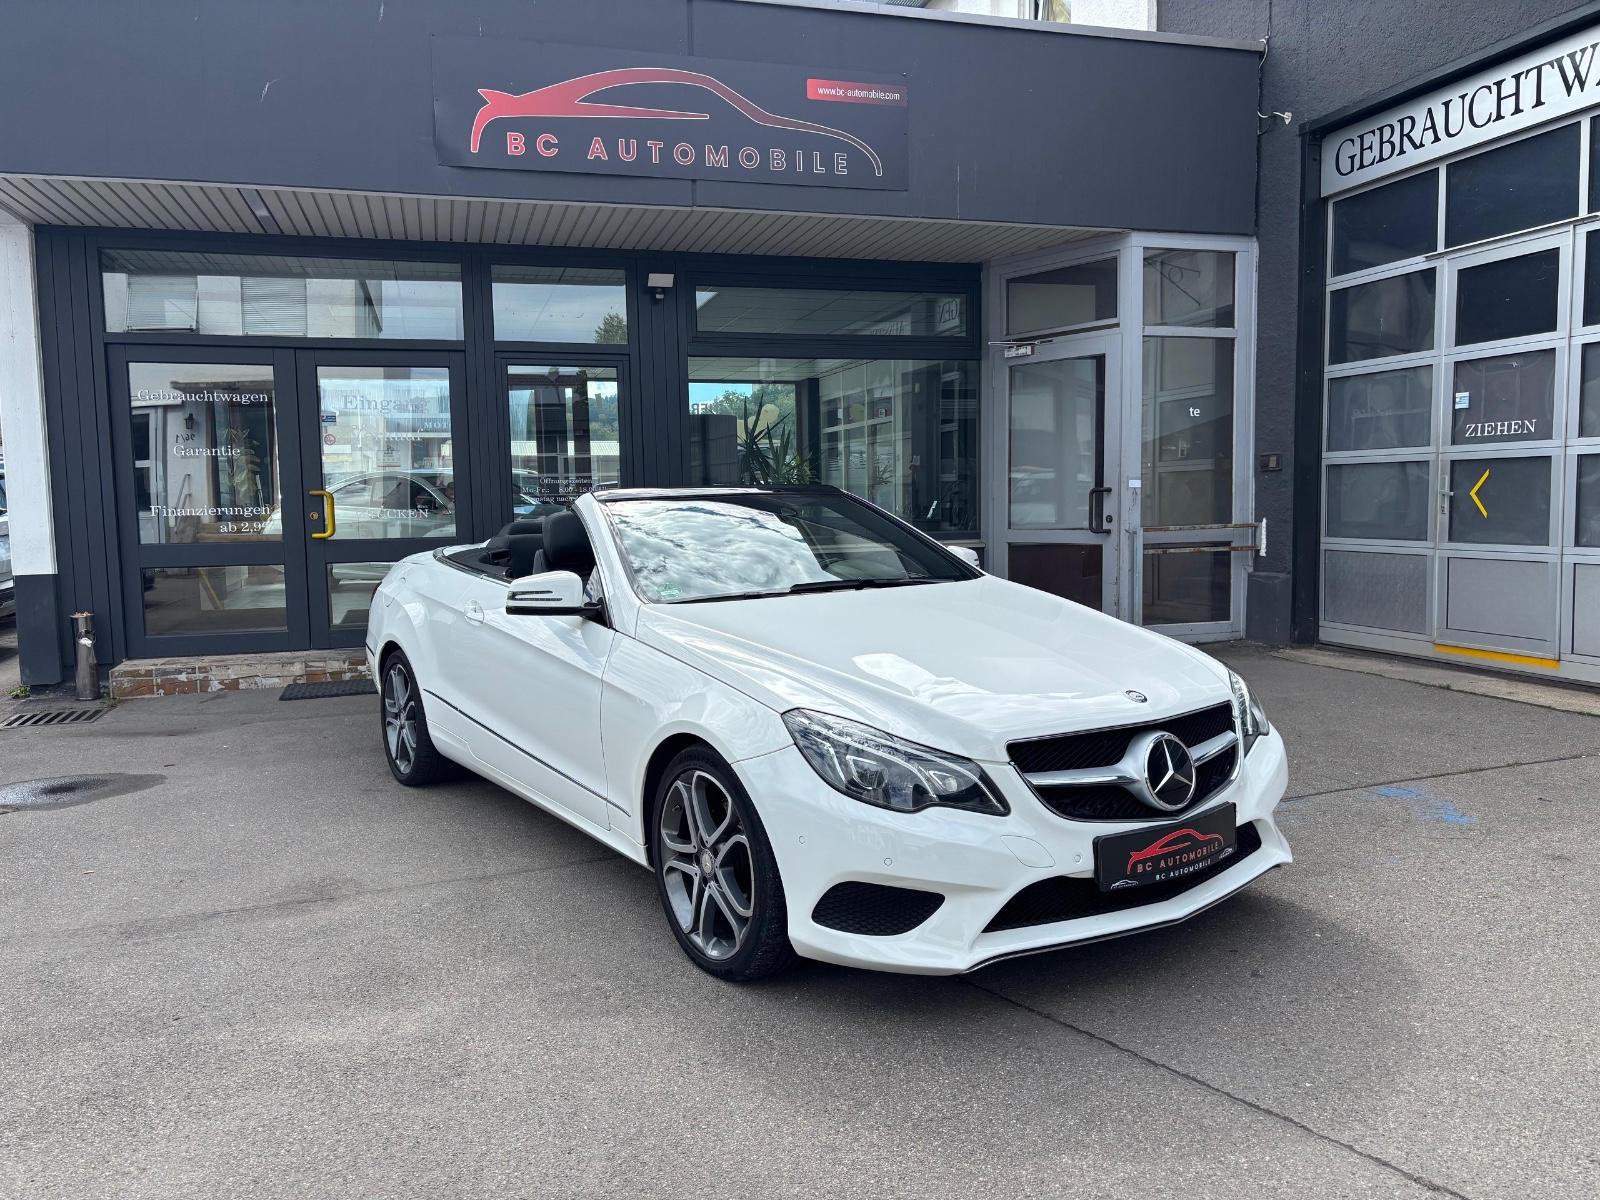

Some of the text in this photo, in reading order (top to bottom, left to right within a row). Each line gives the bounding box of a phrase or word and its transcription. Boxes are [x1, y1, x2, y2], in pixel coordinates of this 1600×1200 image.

[817, 86, 901, 101] www.bc-automobile.com
[1335, 41, 1600, 177] GEBRAUCHTW
[506, 131, 848, 175] BC AUTOMOBILE
[137, 390, 269, 405] Gebrauchtwagen
[341, 394, 430, 415] Eingang
[1189, 406, 1201, 417] te
[1465, 419, 1537, 438] ZIEHEN
[173, 445, 241, 457] Garantie
[150, 504, 270, 517] Finanzierungen
[220, 522, 237, 533] ab
[1137, 861, 1153, 873] BC
[1159, 841, 1219, 868] AUTOMOBILE
[1155, 858, 1211, 880] BC AUTOMOBILE
